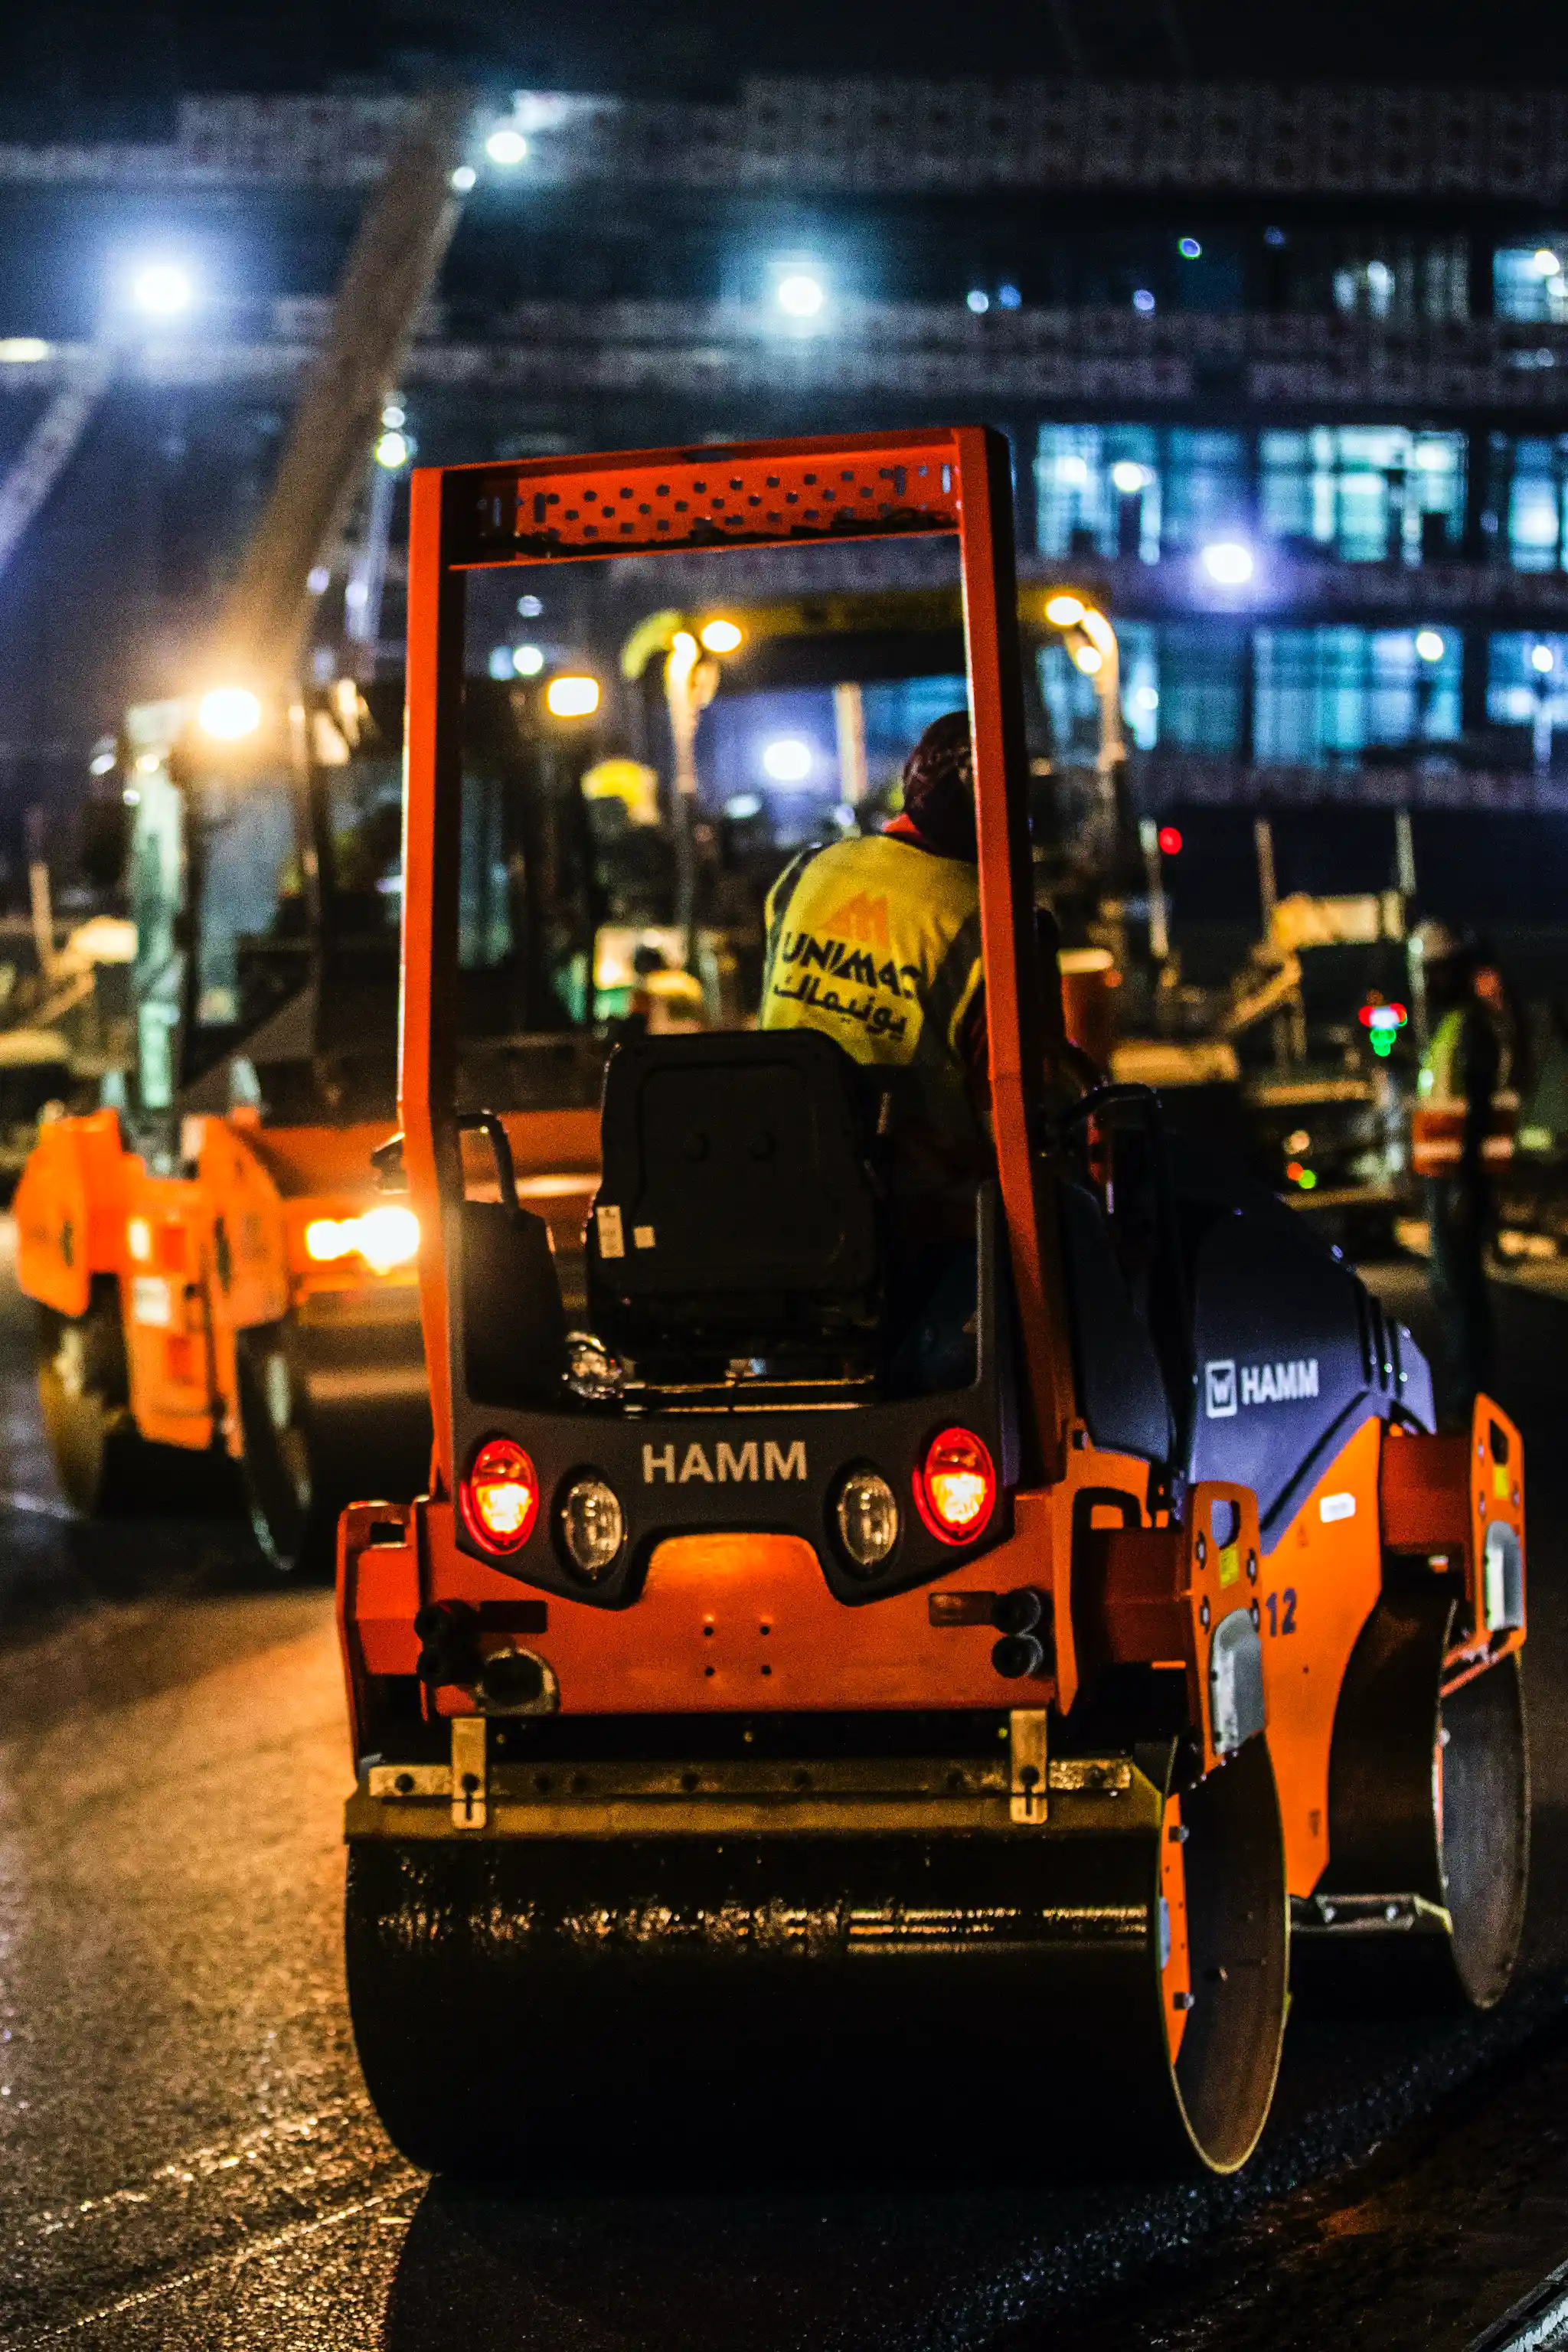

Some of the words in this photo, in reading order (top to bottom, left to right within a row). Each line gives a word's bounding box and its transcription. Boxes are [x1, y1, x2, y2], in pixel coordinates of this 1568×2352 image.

[1241, 1358, 1319, 1406] HAMM
[642, 1440, 807, 1484] HAMM
[1266, 1587, 1297, 1637] 12
